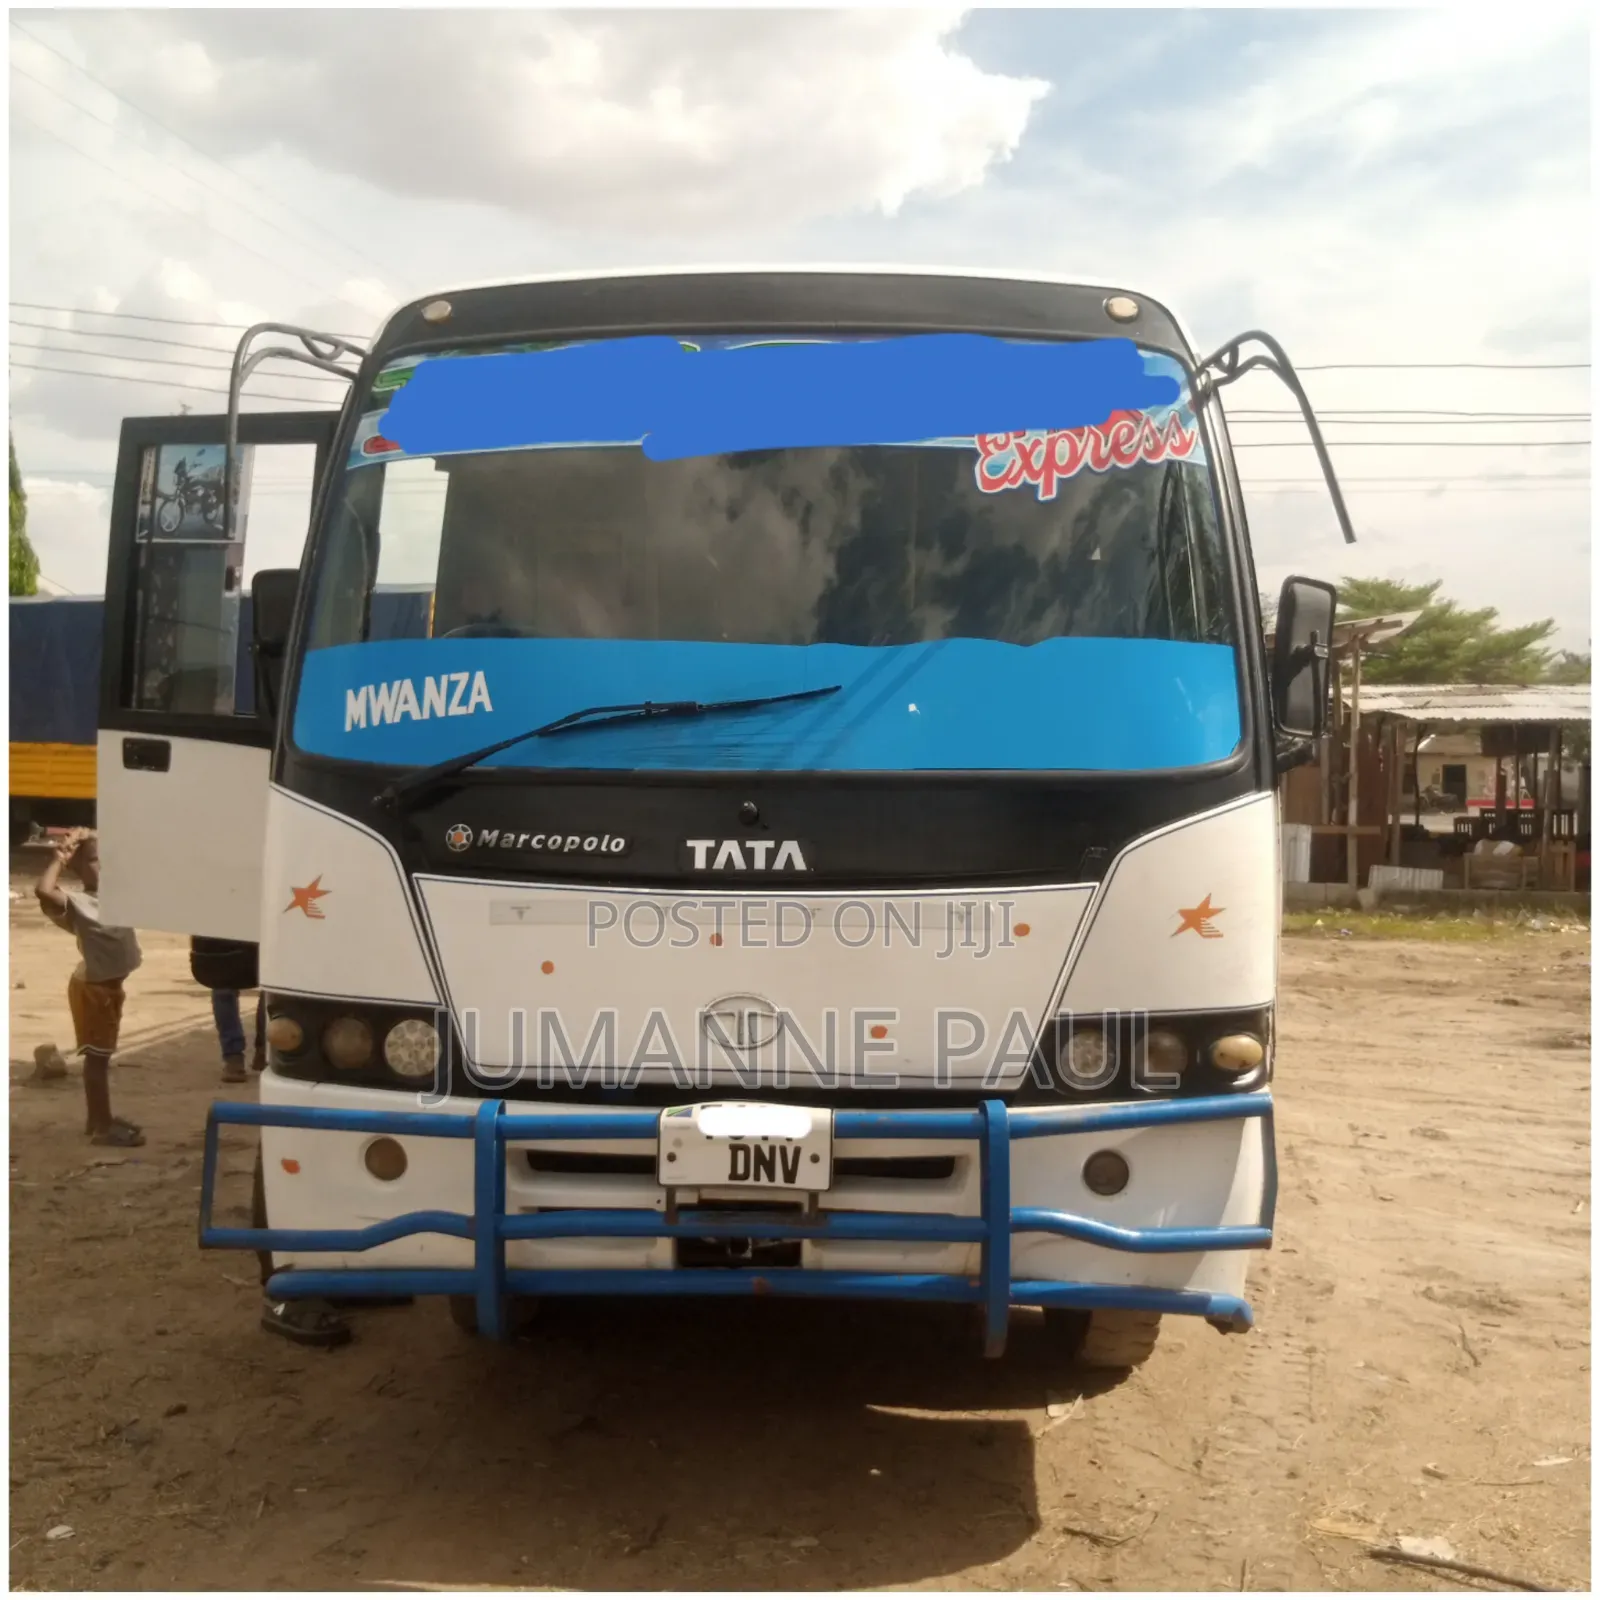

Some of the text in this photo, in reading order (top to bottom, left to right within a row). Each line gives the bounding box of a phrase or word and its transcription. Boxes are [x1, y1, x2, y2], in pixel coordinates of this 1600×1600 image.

[976, 410, 1198, 501] Express
[344, 670, 494, 732] MWANZA
[477, 828, 626, 853] Marcopolo
[686, 839, 808, 871] TATA
[728, 1143, 802, 1184] DNV
